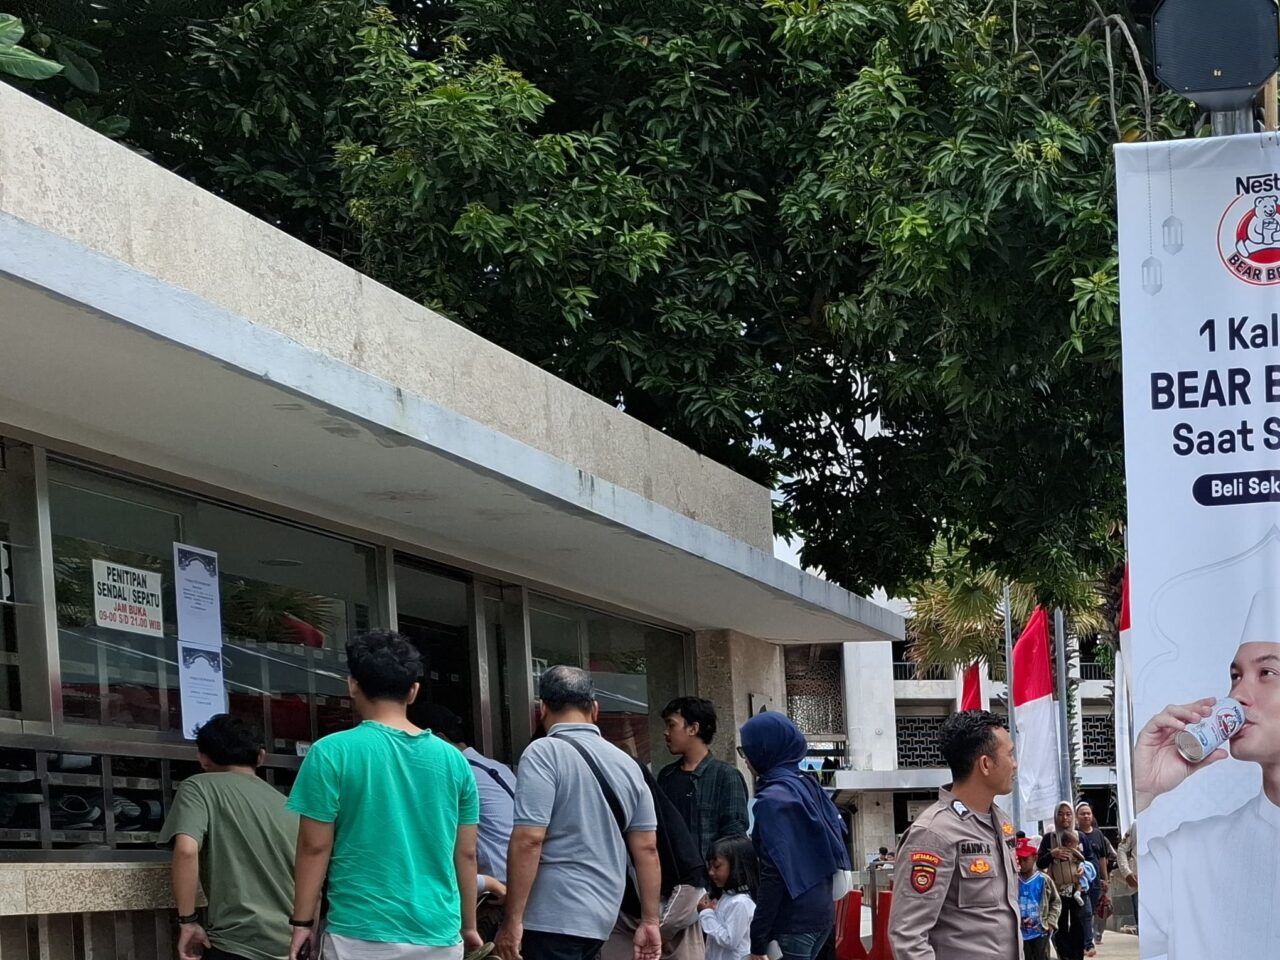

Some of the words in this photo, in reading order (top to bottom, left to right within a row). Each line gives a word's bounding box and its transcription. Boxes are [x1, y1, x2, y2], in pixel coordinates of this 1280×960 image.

[1228, 254, 1261, 280] BEAR
[1200, 319, 1215, 352] 1
[1151, 367, 1252, 410] BEAR
[1173, 420, 1254, 456] Saat
[1211, 479, 1243, 498] Beli
[106, 566, 148, 589] PENITIPAN
[97, 581, 127, 601] SENDAL
[132, 589, 160, 608] SEPATU
[113, 603, 128, 614] JAM
[128, 605, 147, 618] BUKA
[149, 620, 161, 631] WIB
